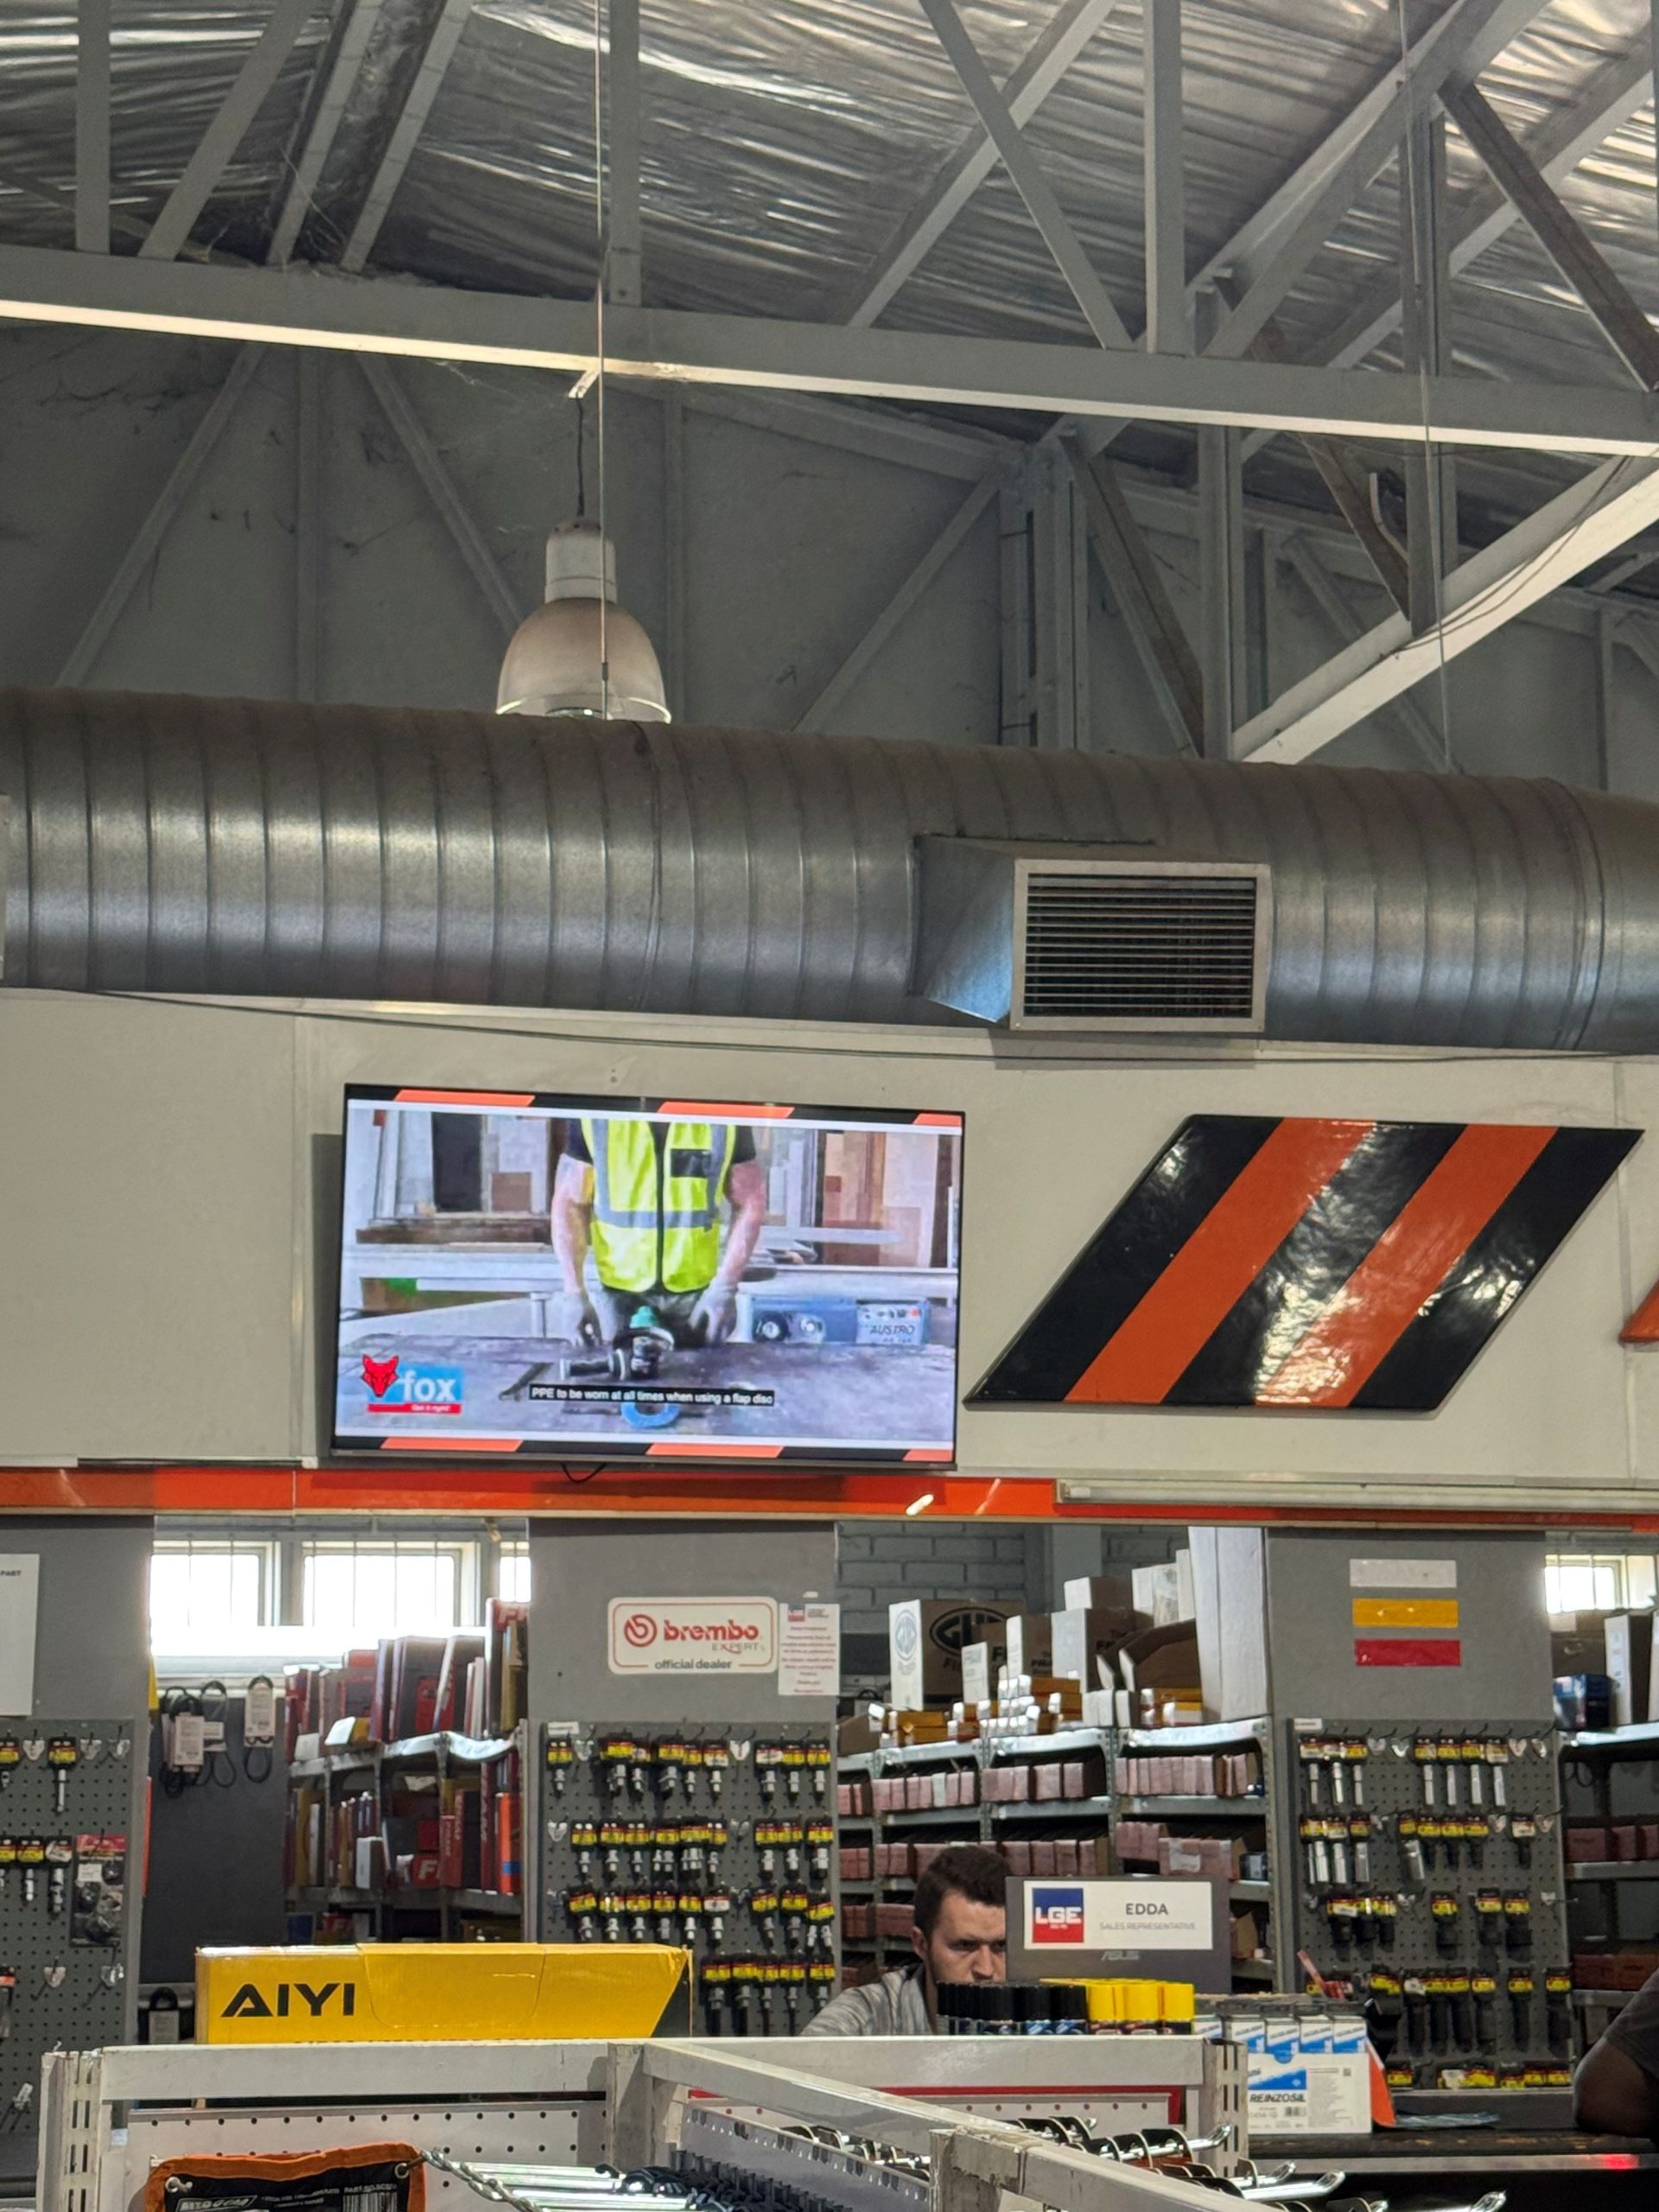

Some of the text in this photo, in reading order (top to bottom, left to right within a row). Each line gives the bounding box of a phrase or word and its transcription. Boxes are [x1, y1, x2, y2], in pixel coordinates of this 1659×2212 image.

[403, 1370, 457, 1402] fox
[531, 1387, 772, 1405] PPE to be worn at all times when using a flap disc
[664, 1618, 760, 1641] brembo
[711, 1643, 760, 1652] EXPERT
[654, 1659, 732, 1669] official dealer
[1035, 1906, 1082, 1924] LGE
[1125, 1903, 1169, 1916] EDDA
[1099, 1921, 1196, 1930] SALES REPRESENTATIVE
[1100, 1950, 1141, 1961] ASUS
[220, 1983, 356, 2018] AIYI
[1249, 2093, 1306, 2103] REINZOSIL
